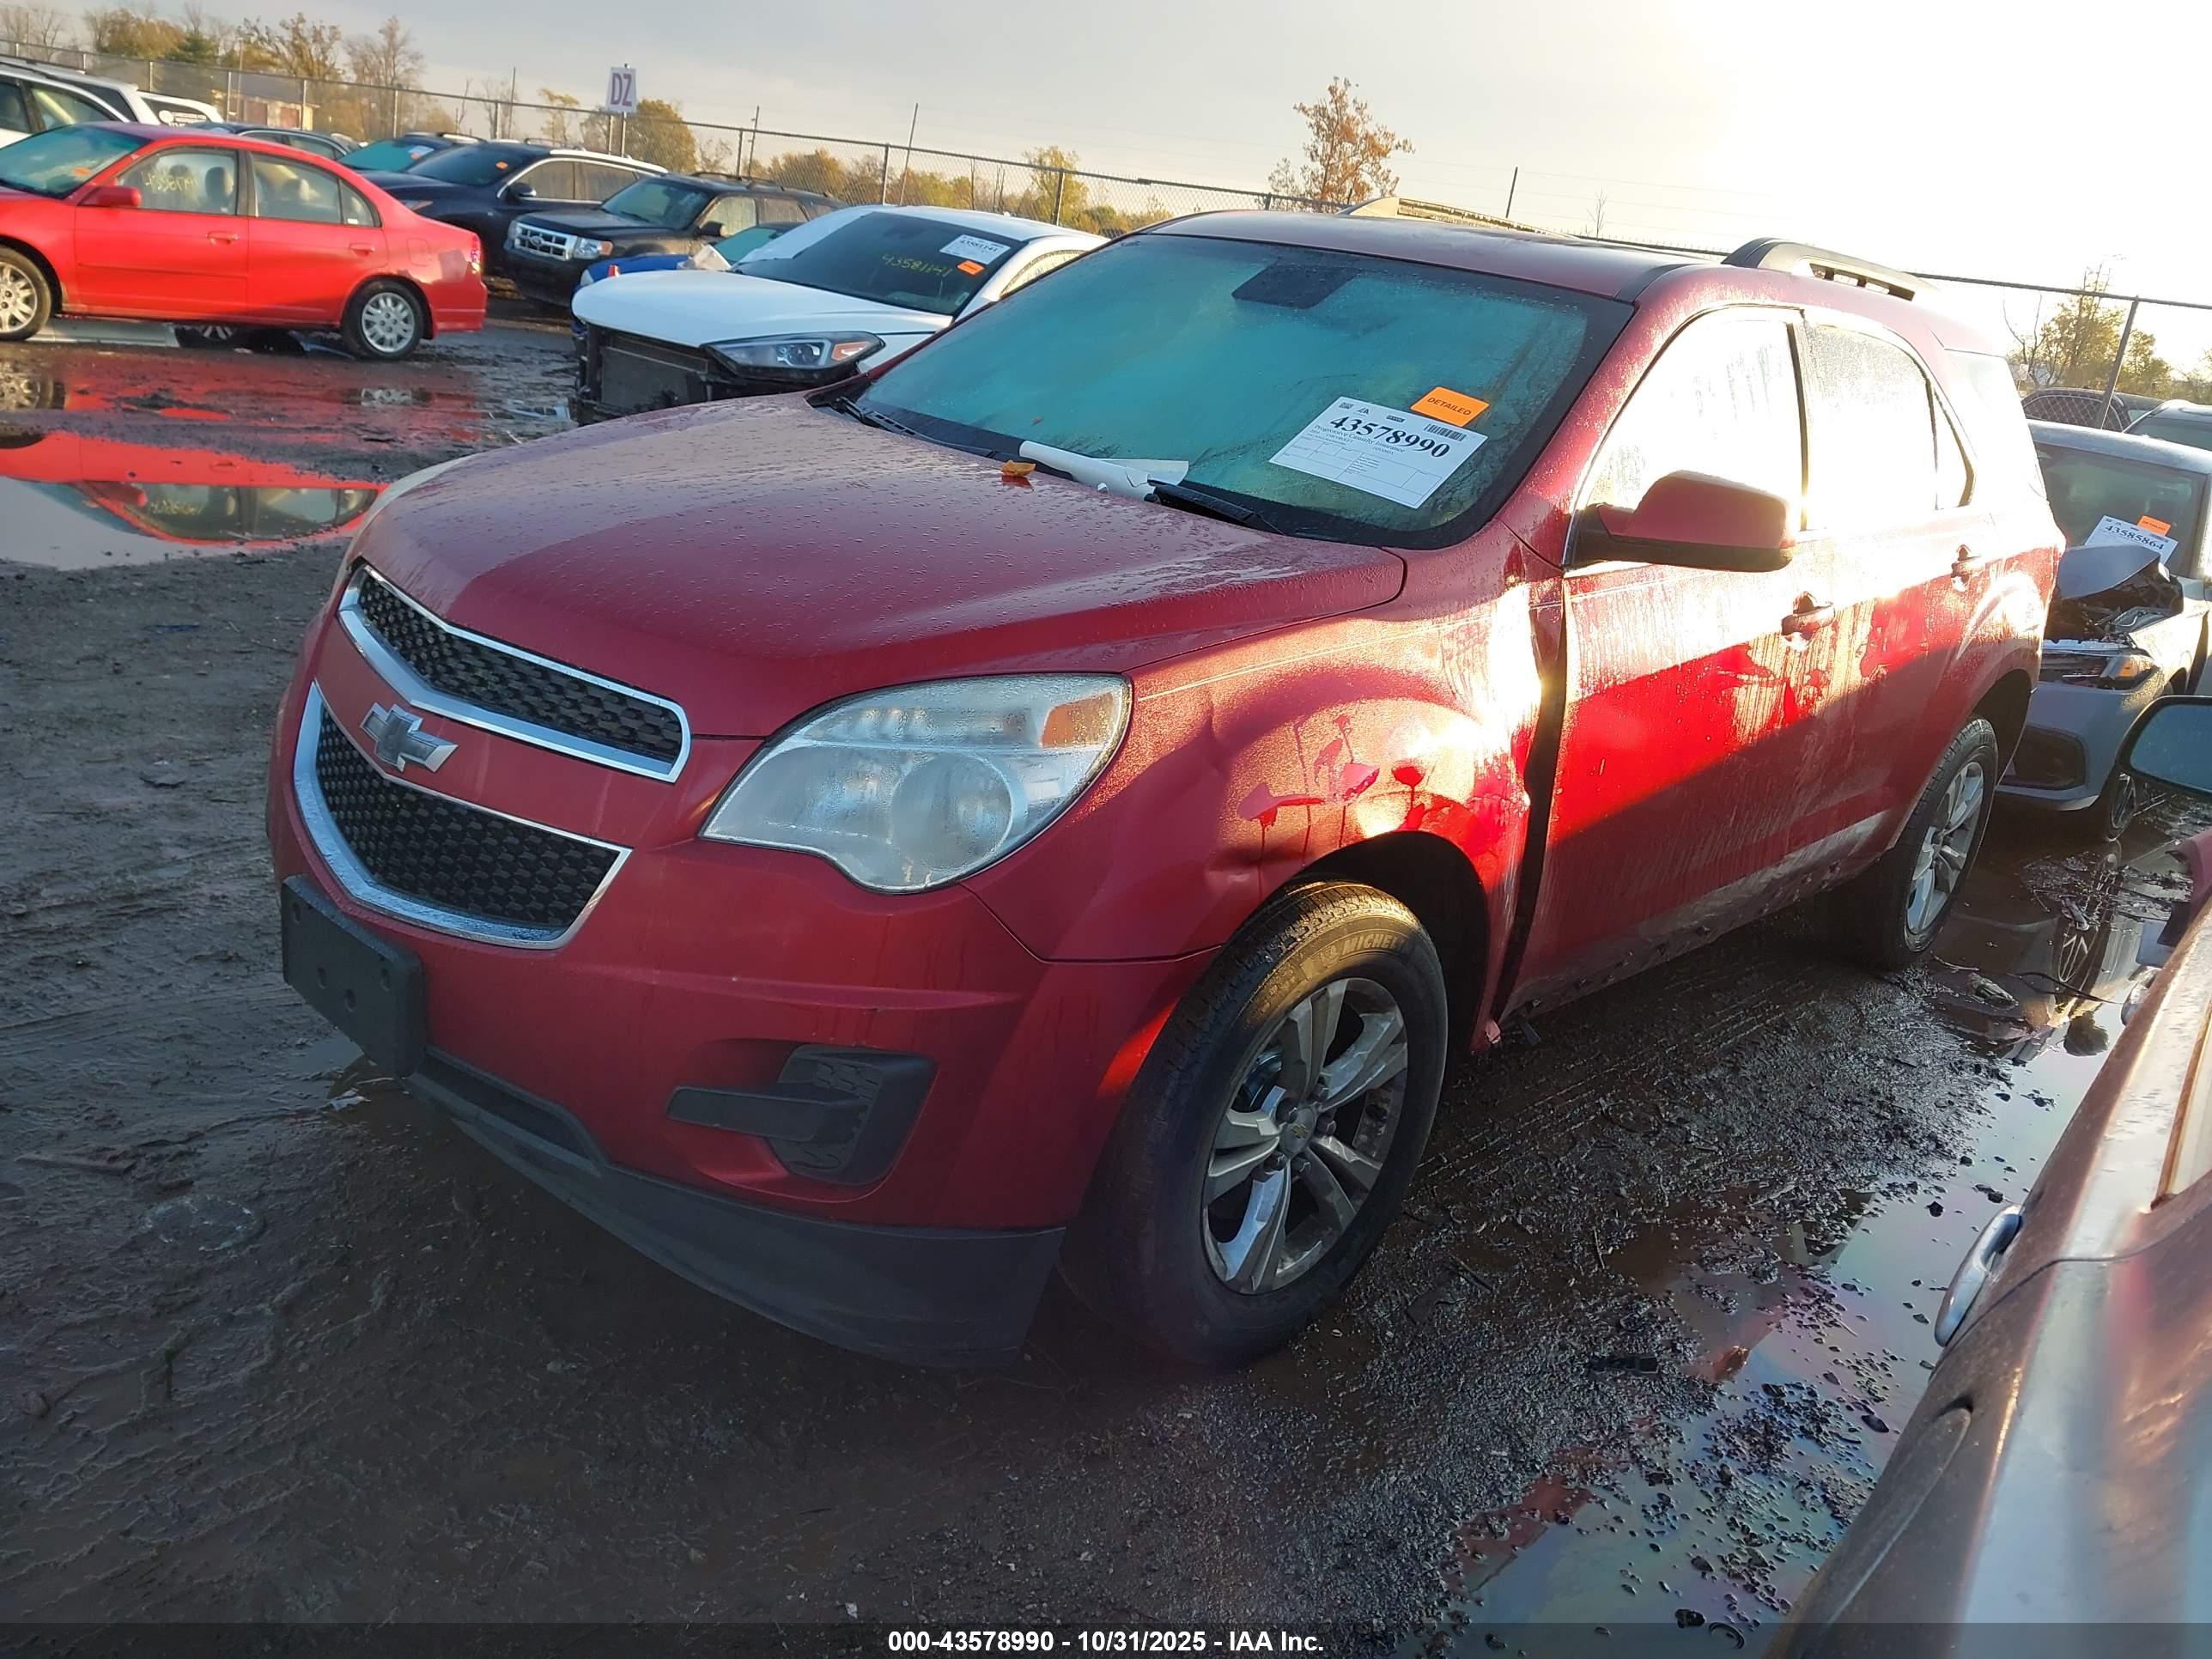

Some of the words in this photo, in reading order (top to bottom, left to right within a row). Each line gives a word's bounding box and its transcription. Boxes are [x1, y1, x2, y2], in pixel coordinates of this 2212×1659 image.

[1427, 397, 1472, 416] DETAILED
[1330, 416, 1450, 458] 43578990
[2105, 526, 2165, 550] 43585864
